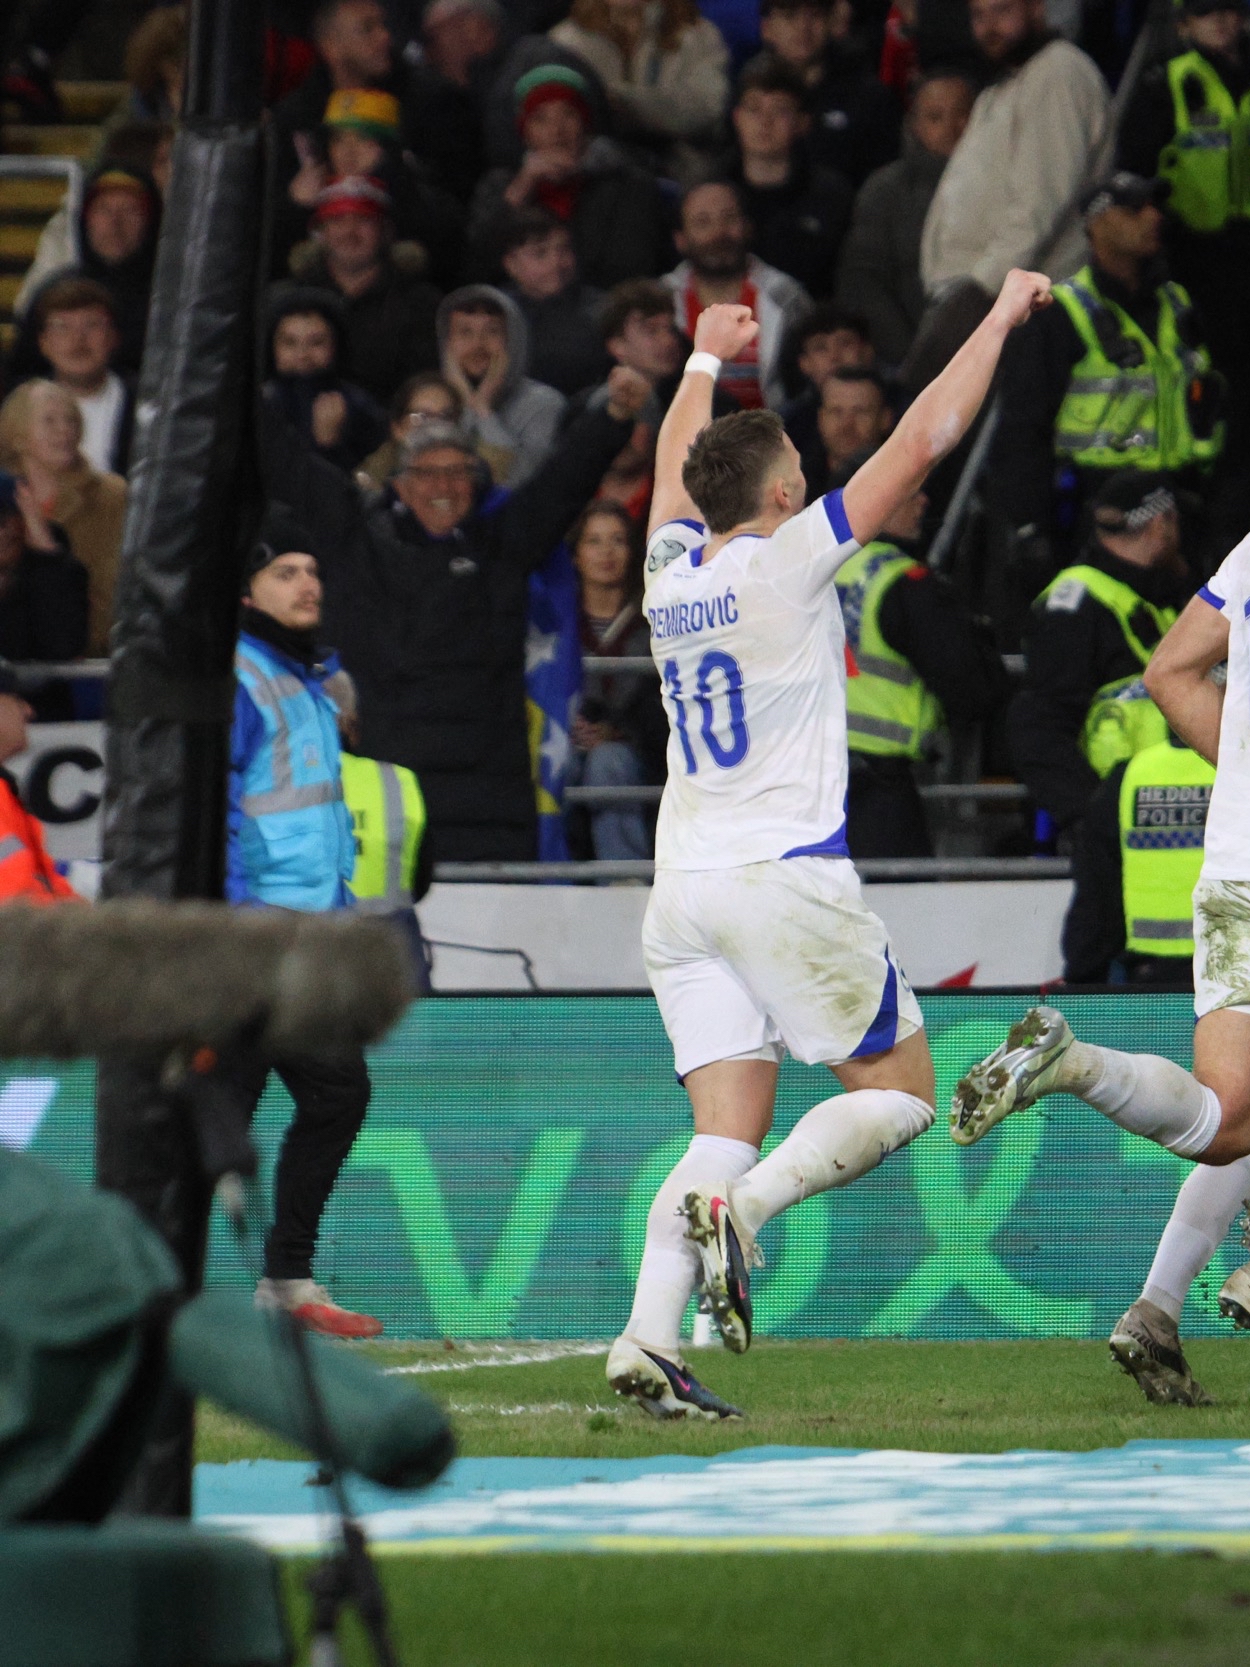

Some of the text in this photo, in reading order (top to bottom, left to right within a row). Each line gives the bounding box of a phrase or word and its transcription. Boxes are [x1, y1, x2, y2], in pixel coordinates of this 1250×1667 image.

[648, 586, 739, 639] DEMIROVIĆ
[663, 647, 750, 776] 10
[29, 745, 104, 823] C
